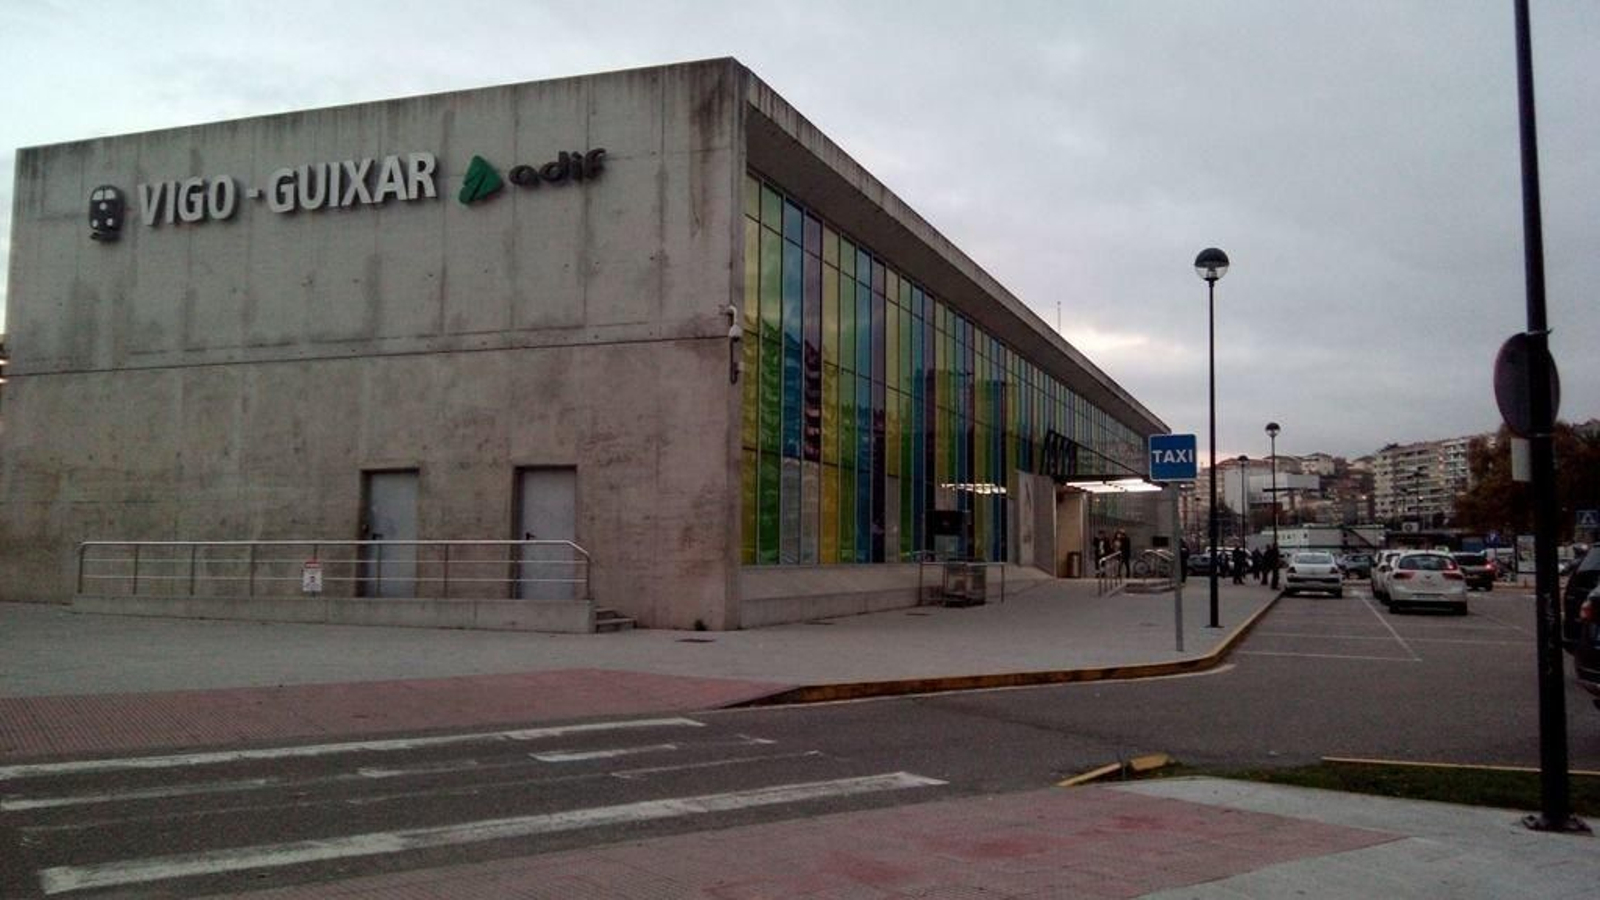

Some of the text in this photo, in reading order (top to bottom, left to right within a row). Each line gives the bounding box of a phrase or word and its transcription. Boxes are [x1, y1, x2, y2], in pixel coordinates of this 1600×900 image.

[509, 148, 606, 187] adif
[137, 175, 236, 226] VIGO
[267, 152, 438, 213] GUIXAR
[1152, 449, 1193, 463] TAXI
